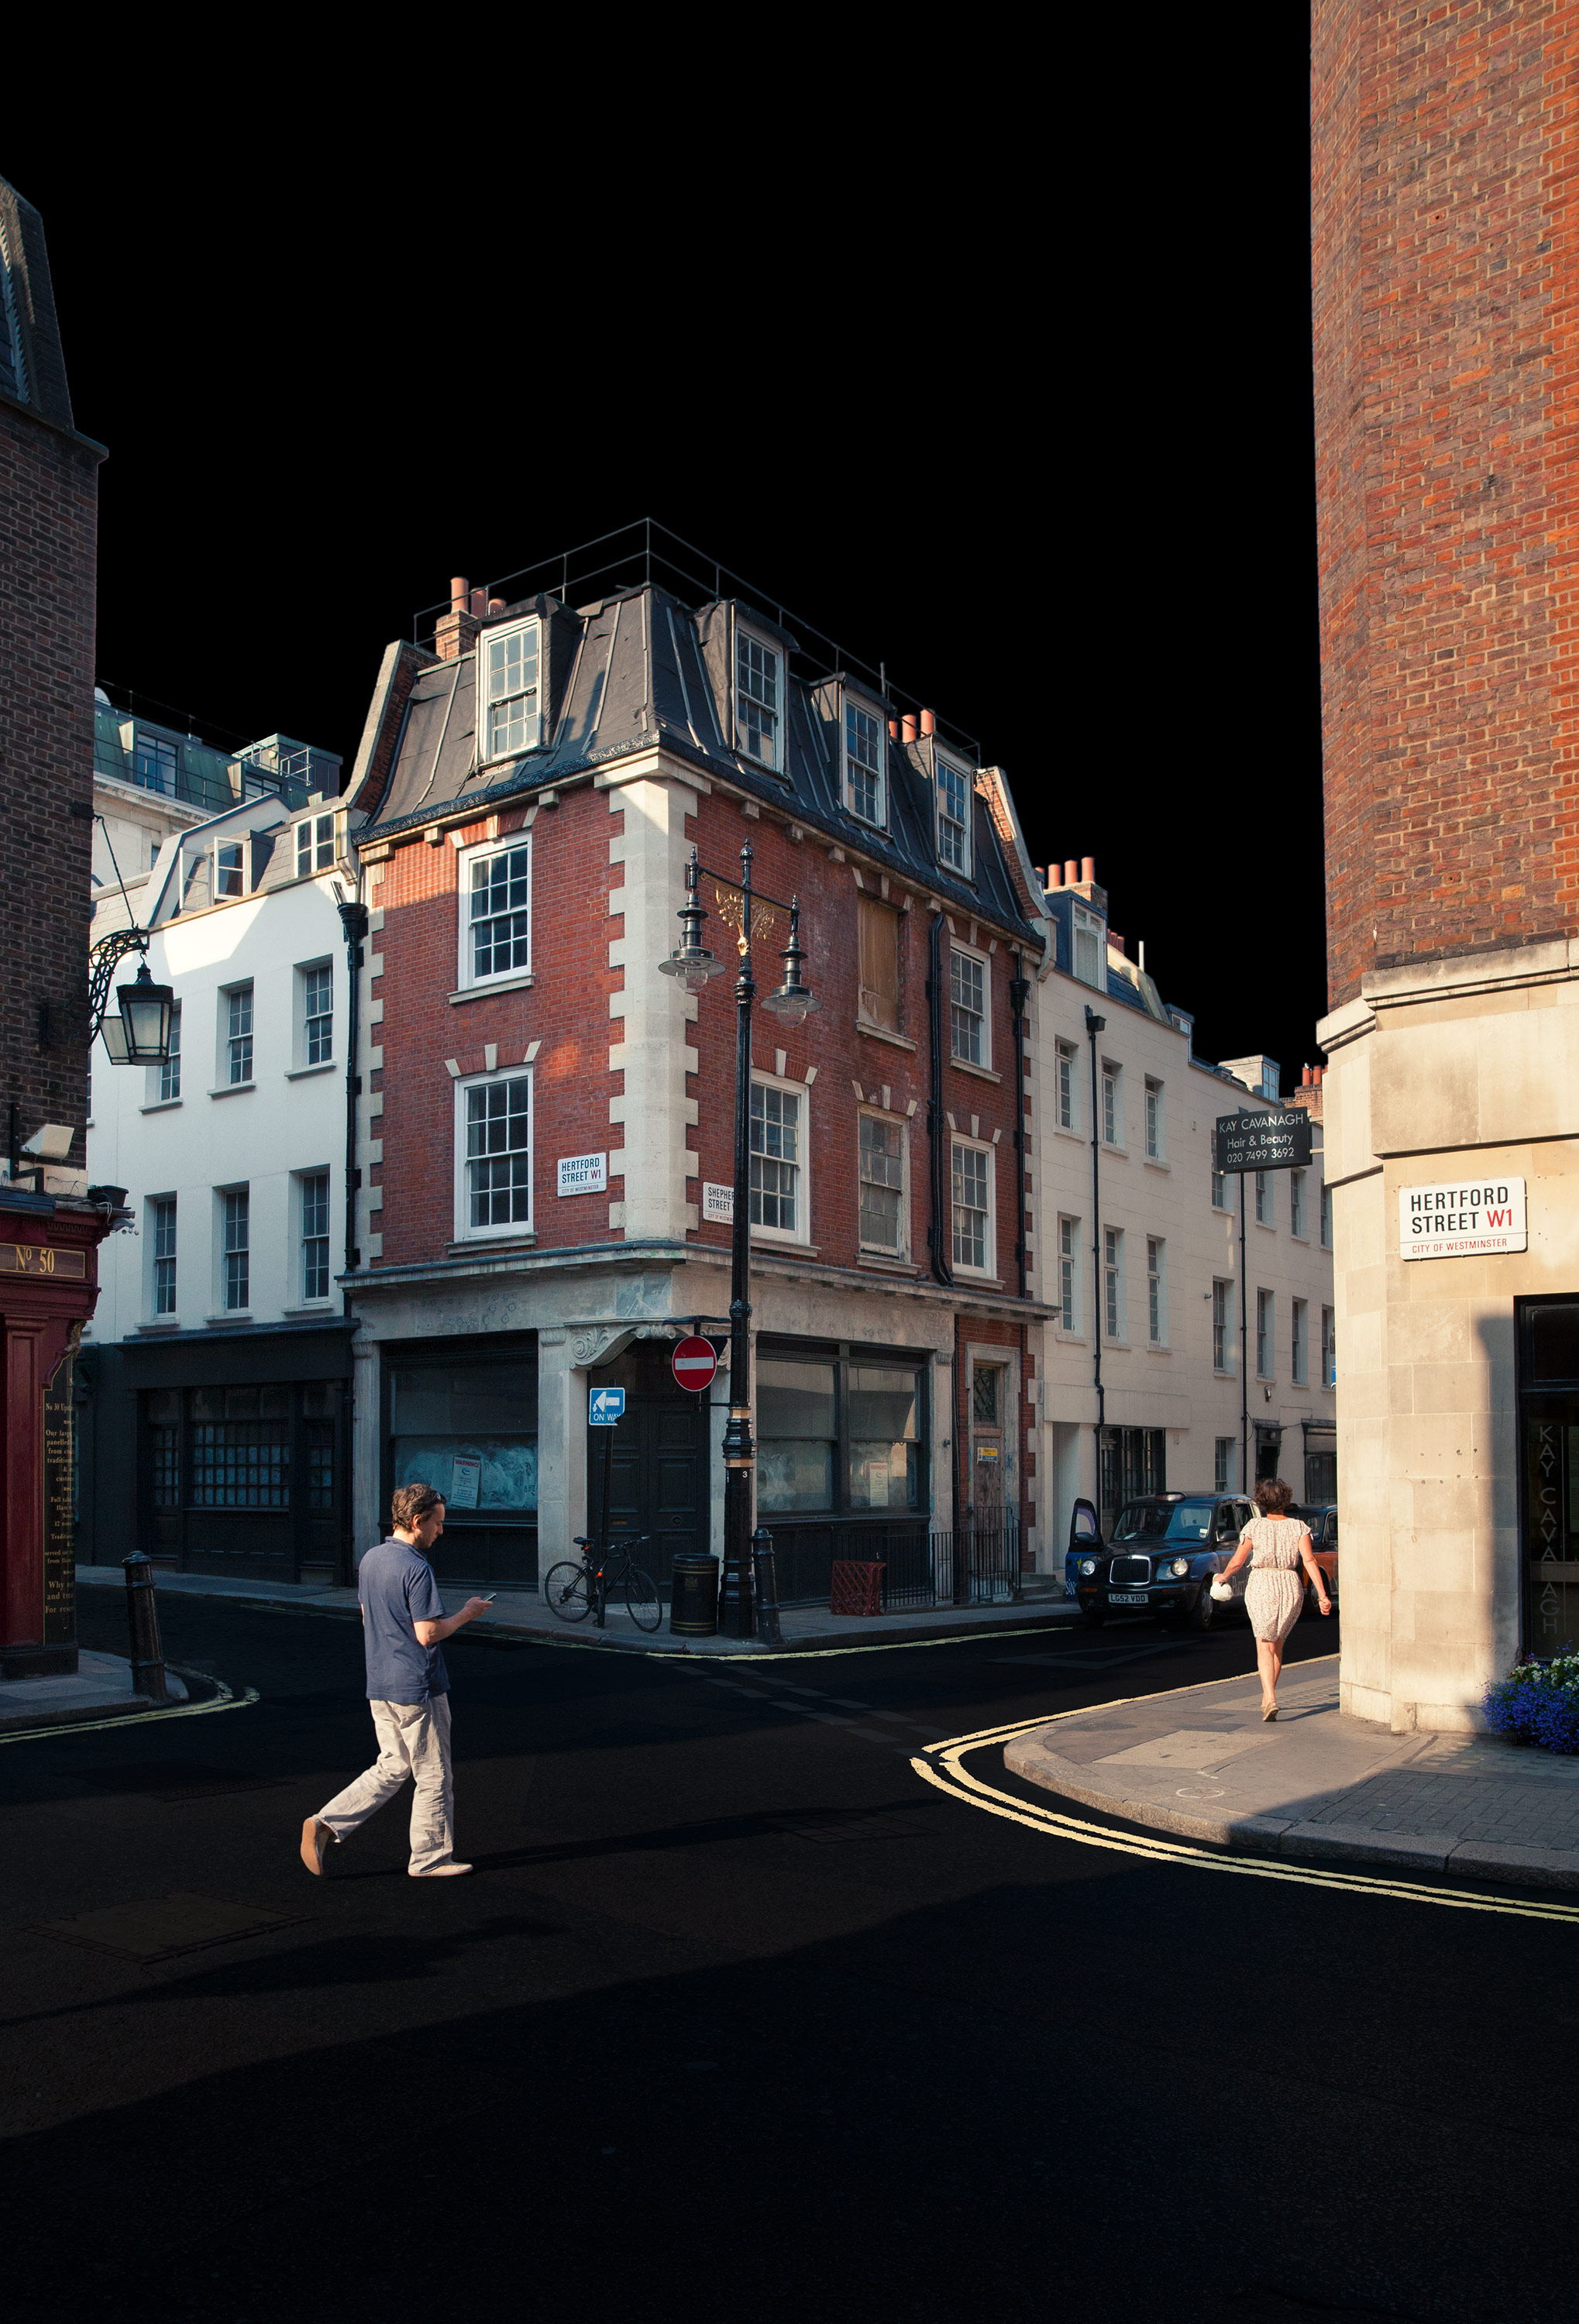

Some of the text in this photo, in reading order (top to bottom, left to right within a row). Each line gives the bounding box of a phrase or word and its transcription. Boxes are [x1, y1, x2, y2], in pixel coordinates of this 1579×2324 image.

[1220, 1114, 1303, 1133] KAY CAVANAGH
[1227, 1134, 1293, 1149] Hair & Beauty
[1227, 1147, 1294, 1164] 020 7499 3692
[562, 1158, 600, 1172] HERTFORD
[562, 1169, 601, 1184] STREET W1
[708, 1186, 734, 1200] SHEPHER
[1411, 1186, 1508, 1212] HERTFORD
[708, 1198, 730, 1211] STREET
[1412, 1209, 1512, 1234] STREET W1
[1412, 1238, 1507, 1253] CITY OF WESTMINSTER
[39, 1249, 55, 1273] 50
[47, 1439, 70, 1447] panelled
[456, 1459, 479, 1468] WARNING!
[1539, 1425, 1560, 1633] KAY CAVAAGH
[48, 1581, 63, 1590] Why
